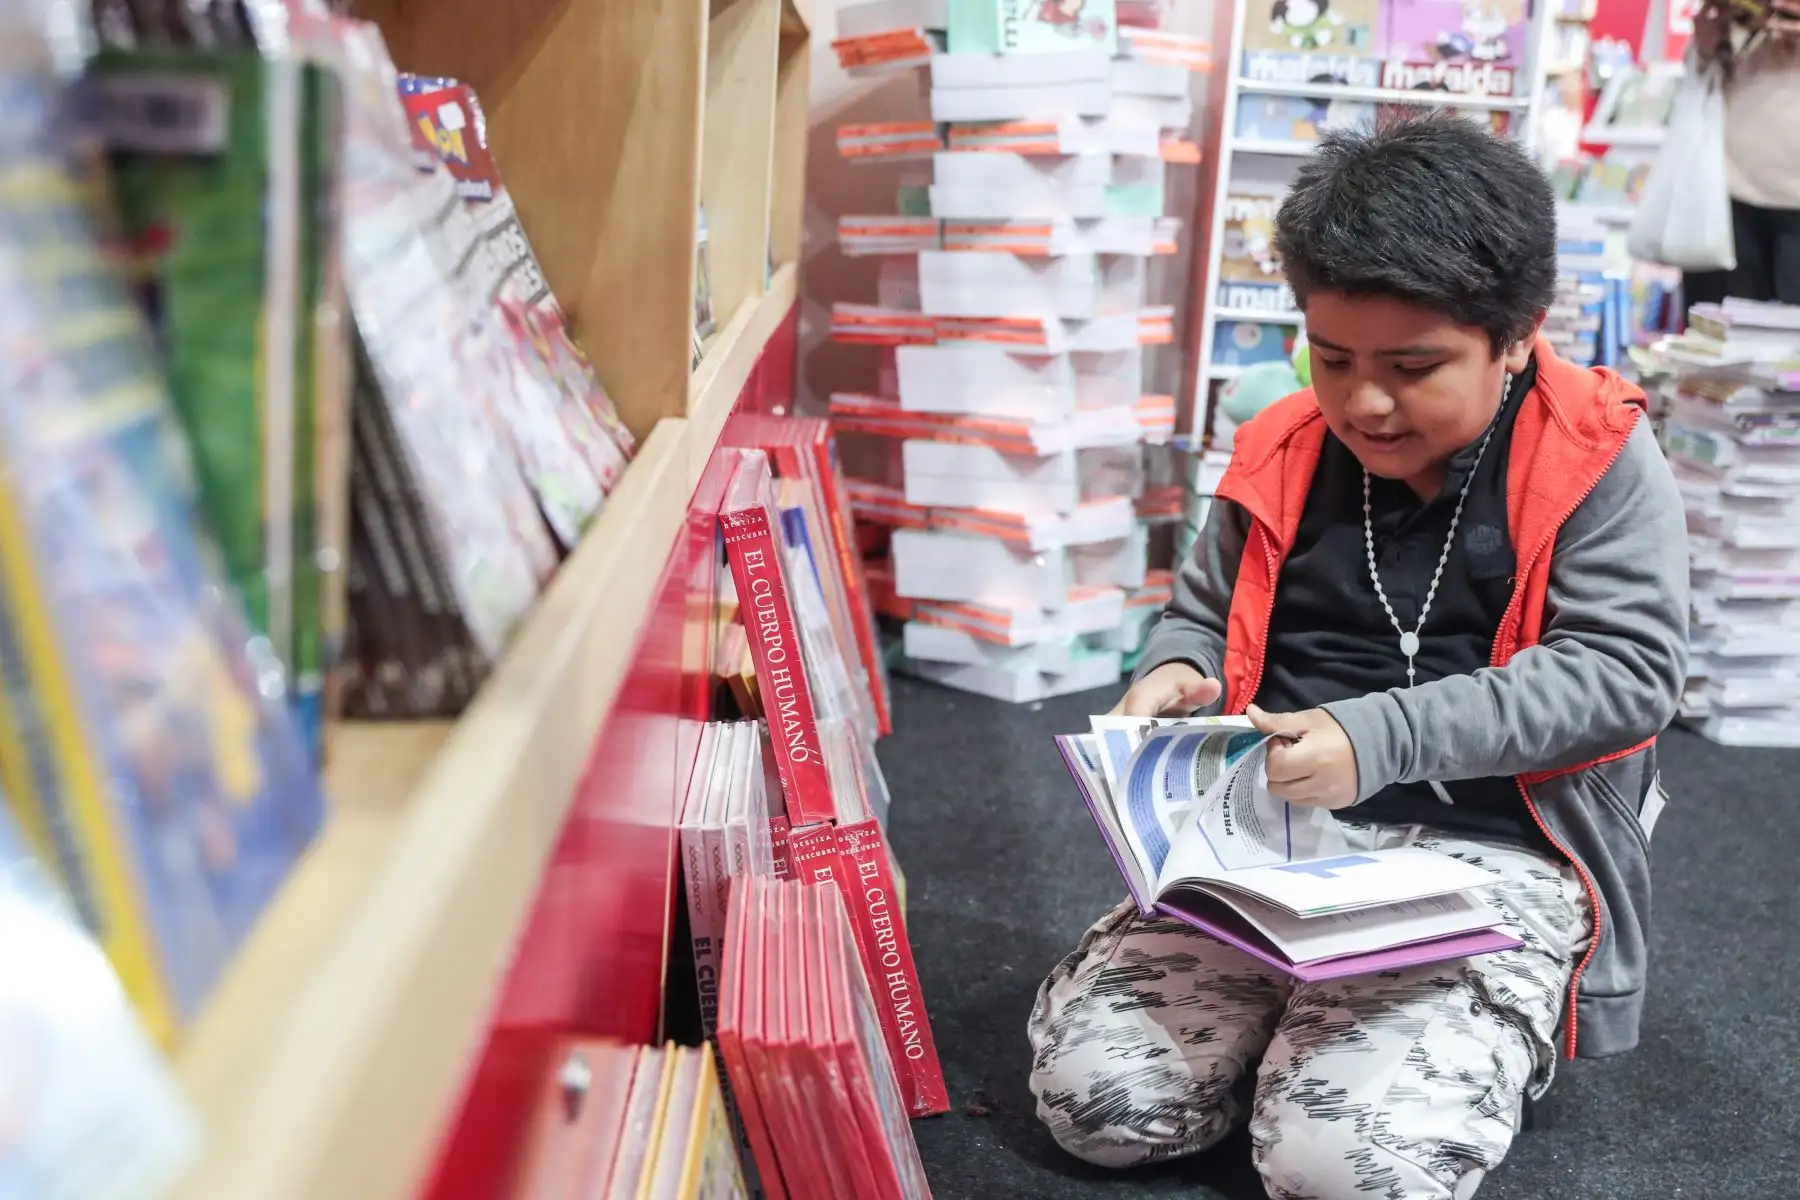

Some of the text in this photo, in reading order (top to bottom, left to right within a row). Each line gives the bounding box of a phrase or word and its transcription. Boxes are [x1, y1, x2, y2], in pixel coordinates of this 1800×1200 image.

[1383, 59, 1513, 95] mafalda
[725, 529, 768, 544] DESCUBRE
[744, 548, 809, 763] EL CUERPO HUMANO
[793, 834, 832, 849] DESLIZA
[795, 846, 837, 862] DESCUBRE
[858, 859, 924, 1060] EL CUERPO HUMANO
[694, 936, 719, 1046] EL CUERP
